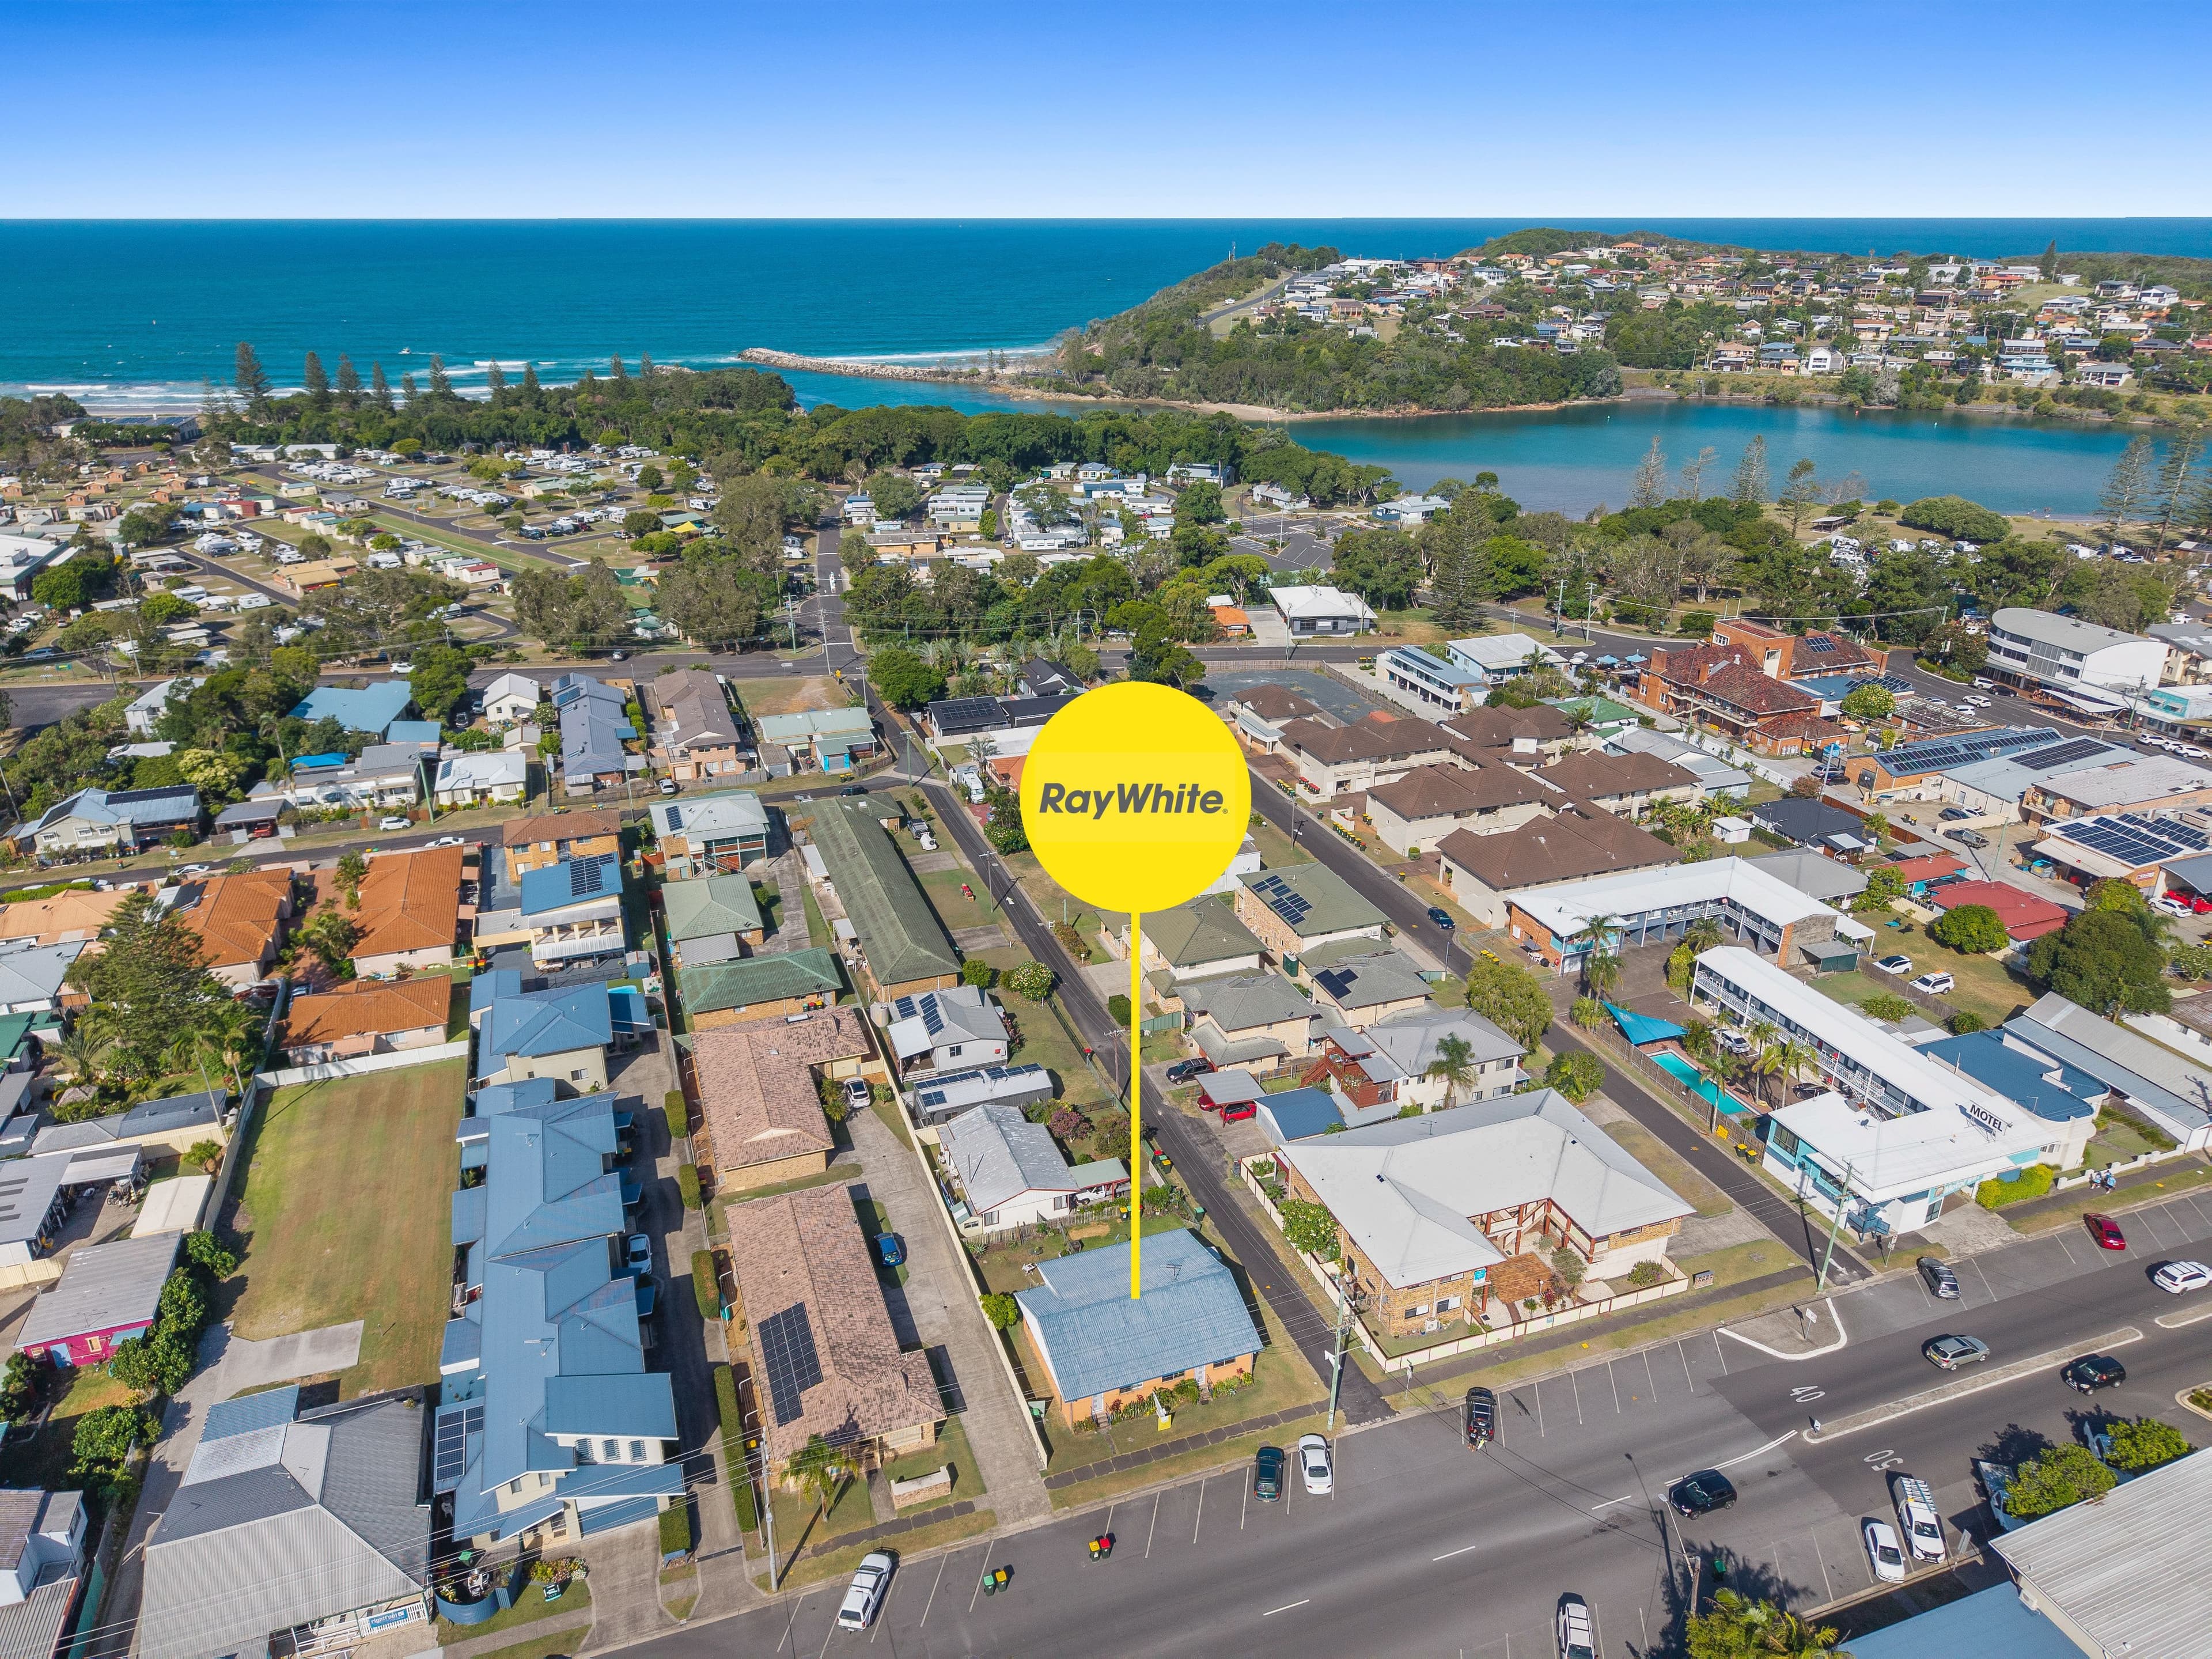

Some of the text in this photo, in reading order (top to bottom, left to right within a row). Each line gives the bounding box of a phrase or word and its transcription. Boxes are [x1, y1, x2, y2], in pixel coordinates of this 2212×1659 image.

[1970, 1104, 2002, 1132] MOTEL
[1790, 1385, 1825, 1403] 40
[1863, 1449, 1903, 1471] 50
